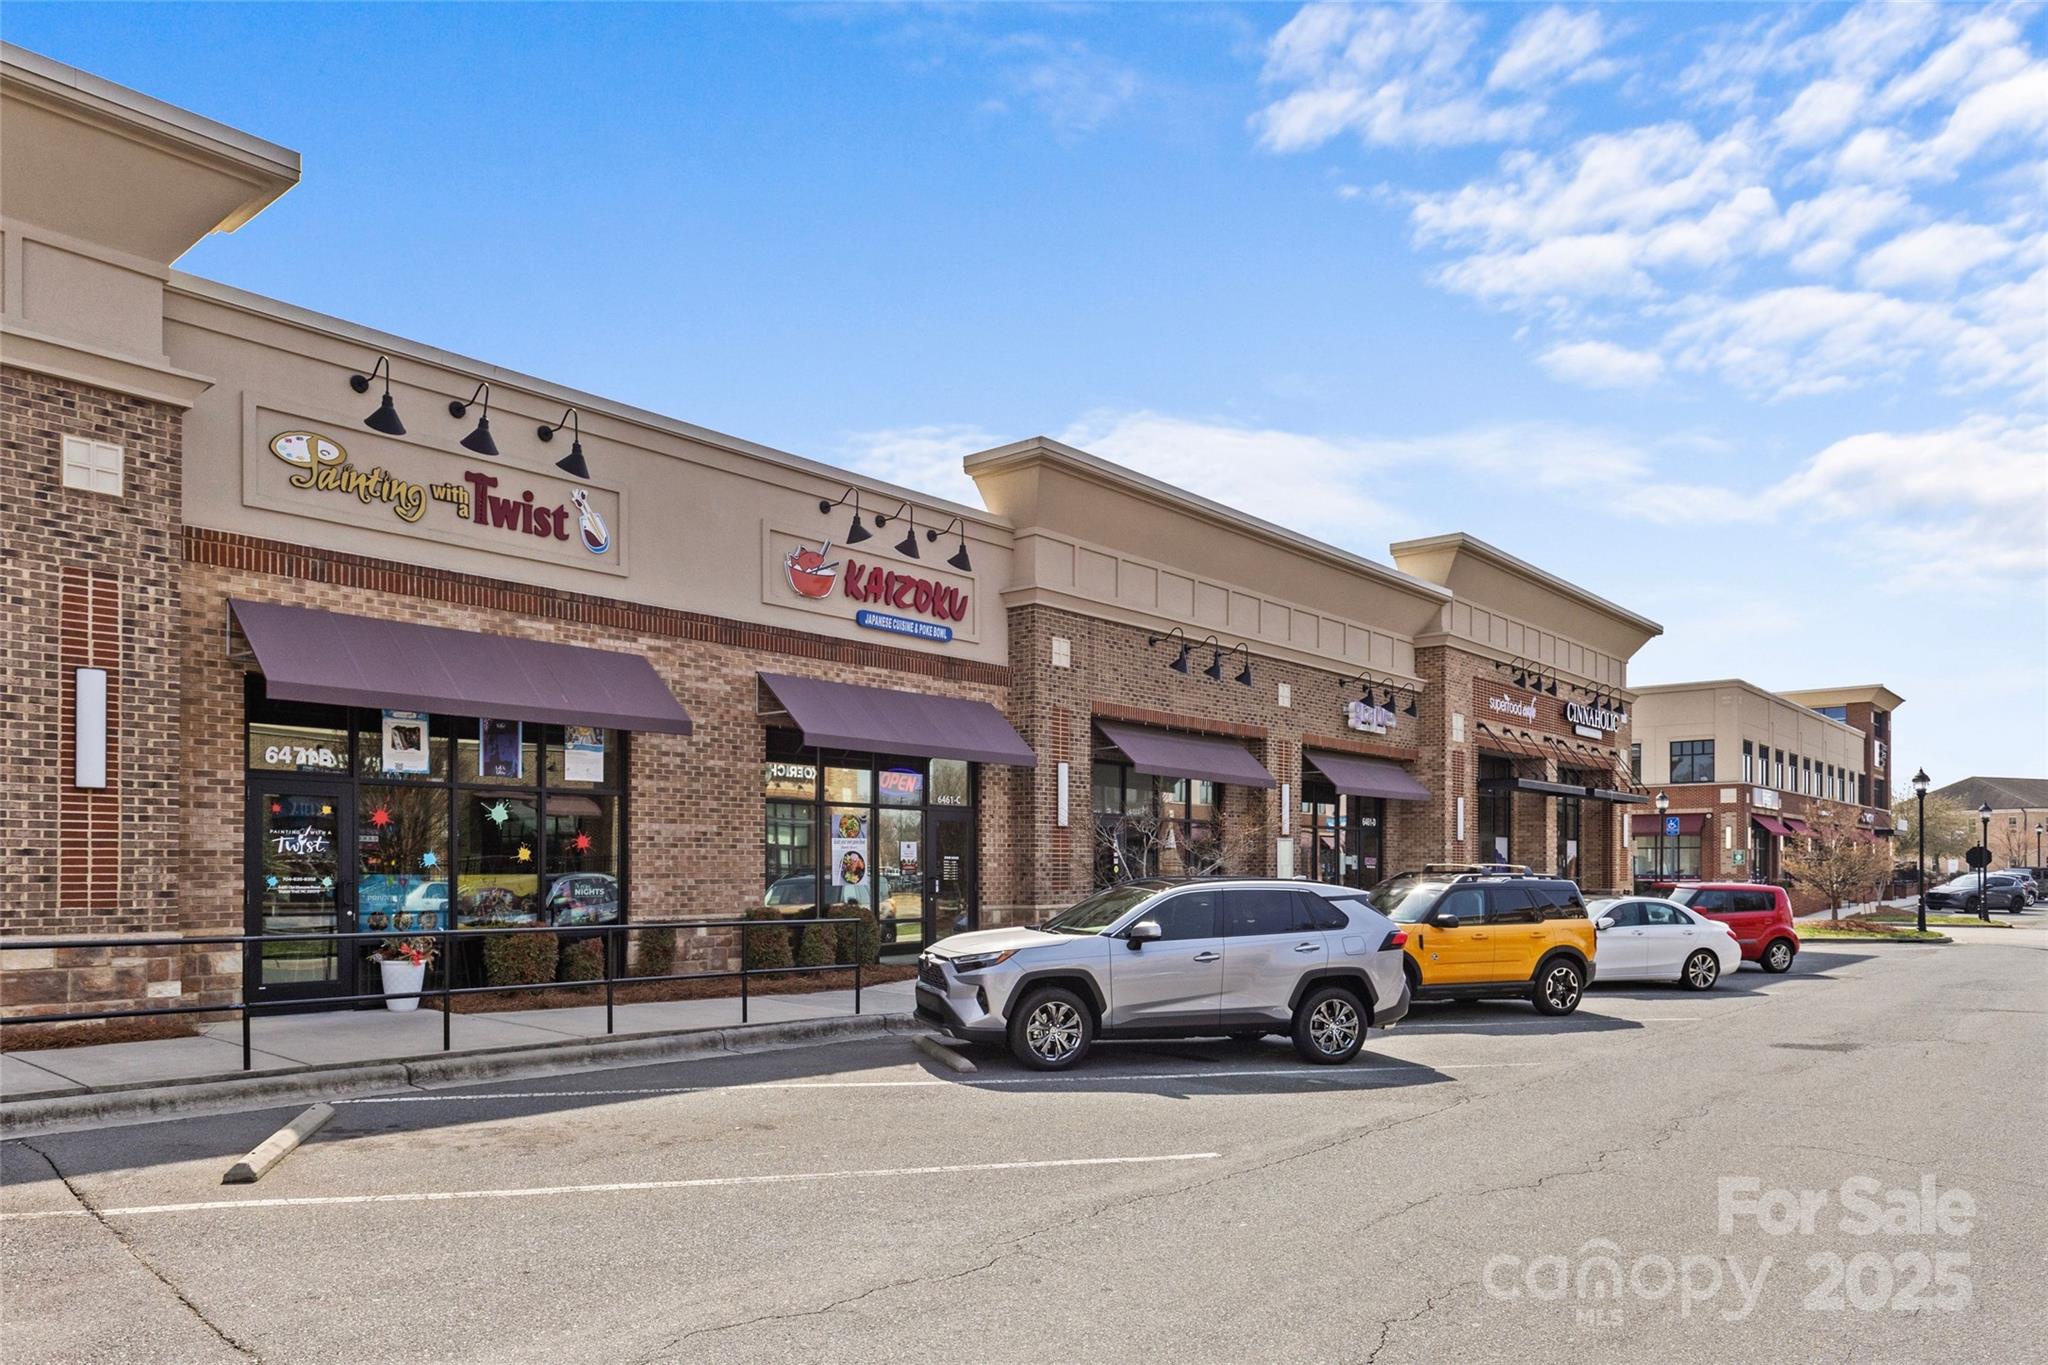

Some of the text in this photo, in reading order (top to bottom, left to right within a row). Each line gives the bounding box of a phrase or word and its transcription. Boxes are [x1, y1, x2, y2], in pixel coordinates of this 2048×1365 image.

[269, 430, 570, 541] Painting with a Twist
[844, 558, 968, 622] KAIZOKU
[865, 613, 893, 629] JAPANESE
[892, 618, 914, 633] CUISINE
[919, 623, 933, 637] POKE
[933, 626, 947, 640] BOWL
[1489, 694, 1523, 716] superfood
[1567, 702, 1619, 733] CINNAHOLIC
[880, 772, 917, 793] OPEN
[574, 887, 605, 896] NIGHTS
